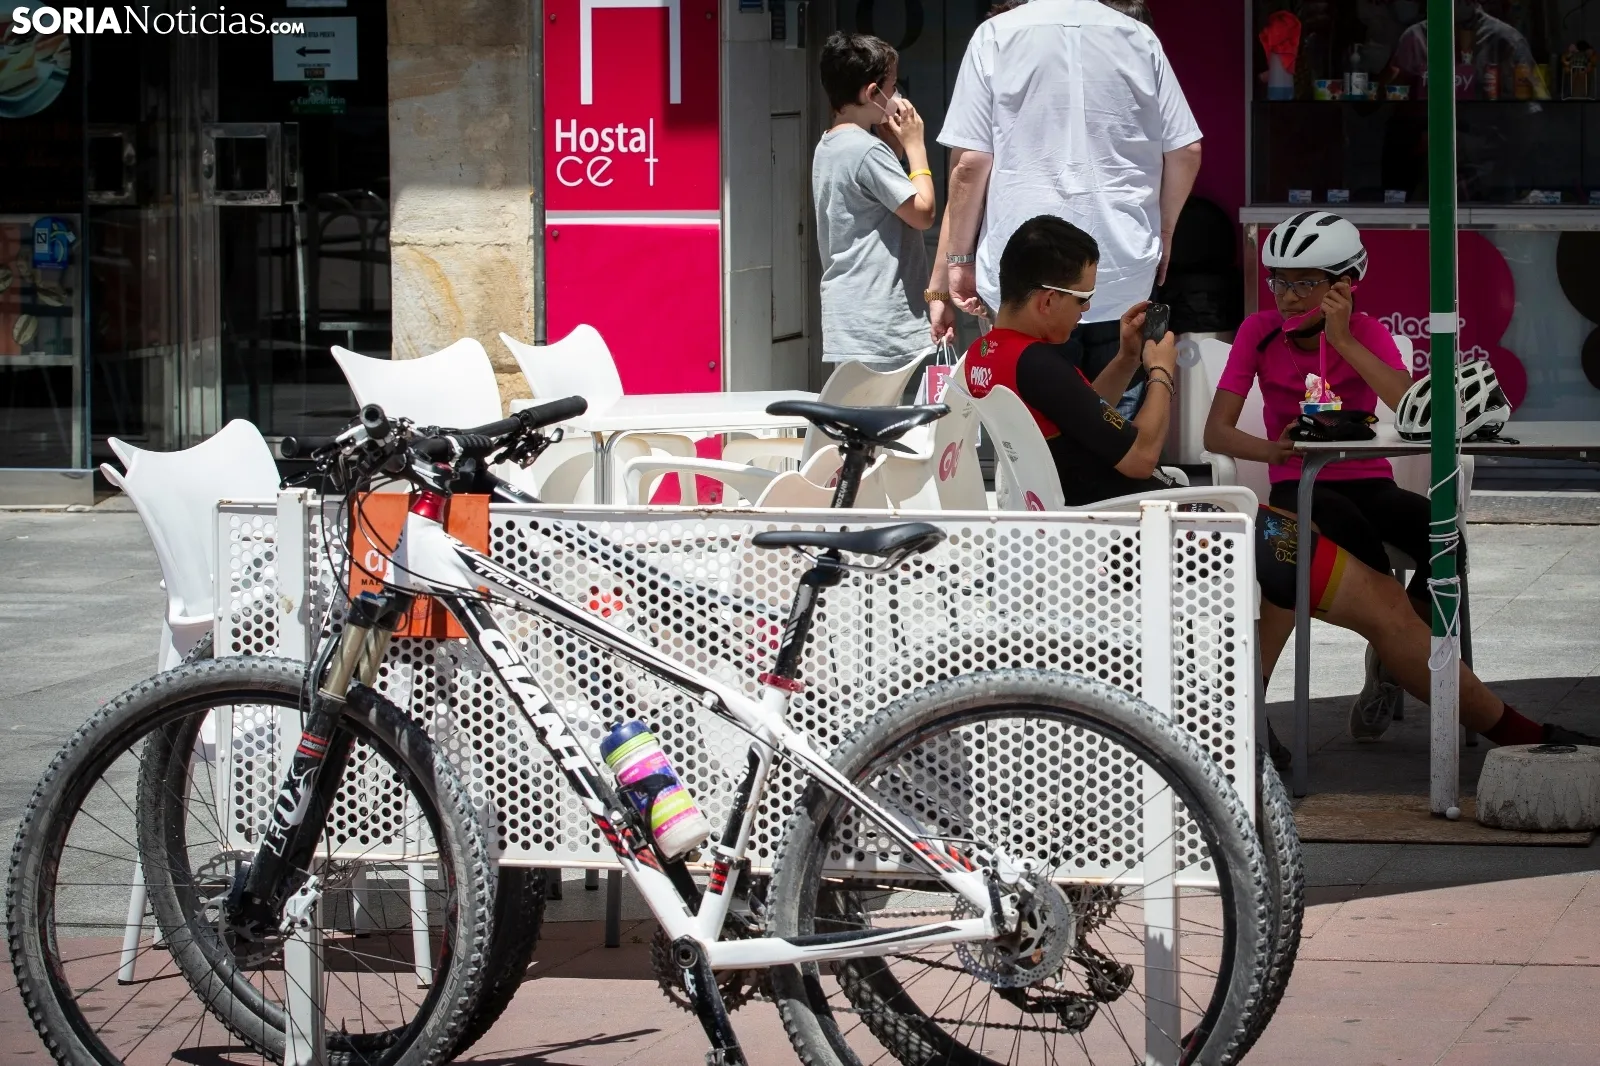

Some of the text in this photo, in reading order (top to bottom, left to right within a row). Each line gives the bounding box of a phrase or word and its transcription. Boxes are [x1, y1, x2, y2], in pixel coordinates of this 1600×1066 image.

[555, 118, 654, 154] Hostal
[473, 560, 540, 600] TALON
[478, 627, 599, 777] GIANT
[263, 762, 319, 858] FOX
[426, 921, 470, 1038] ROCKET
